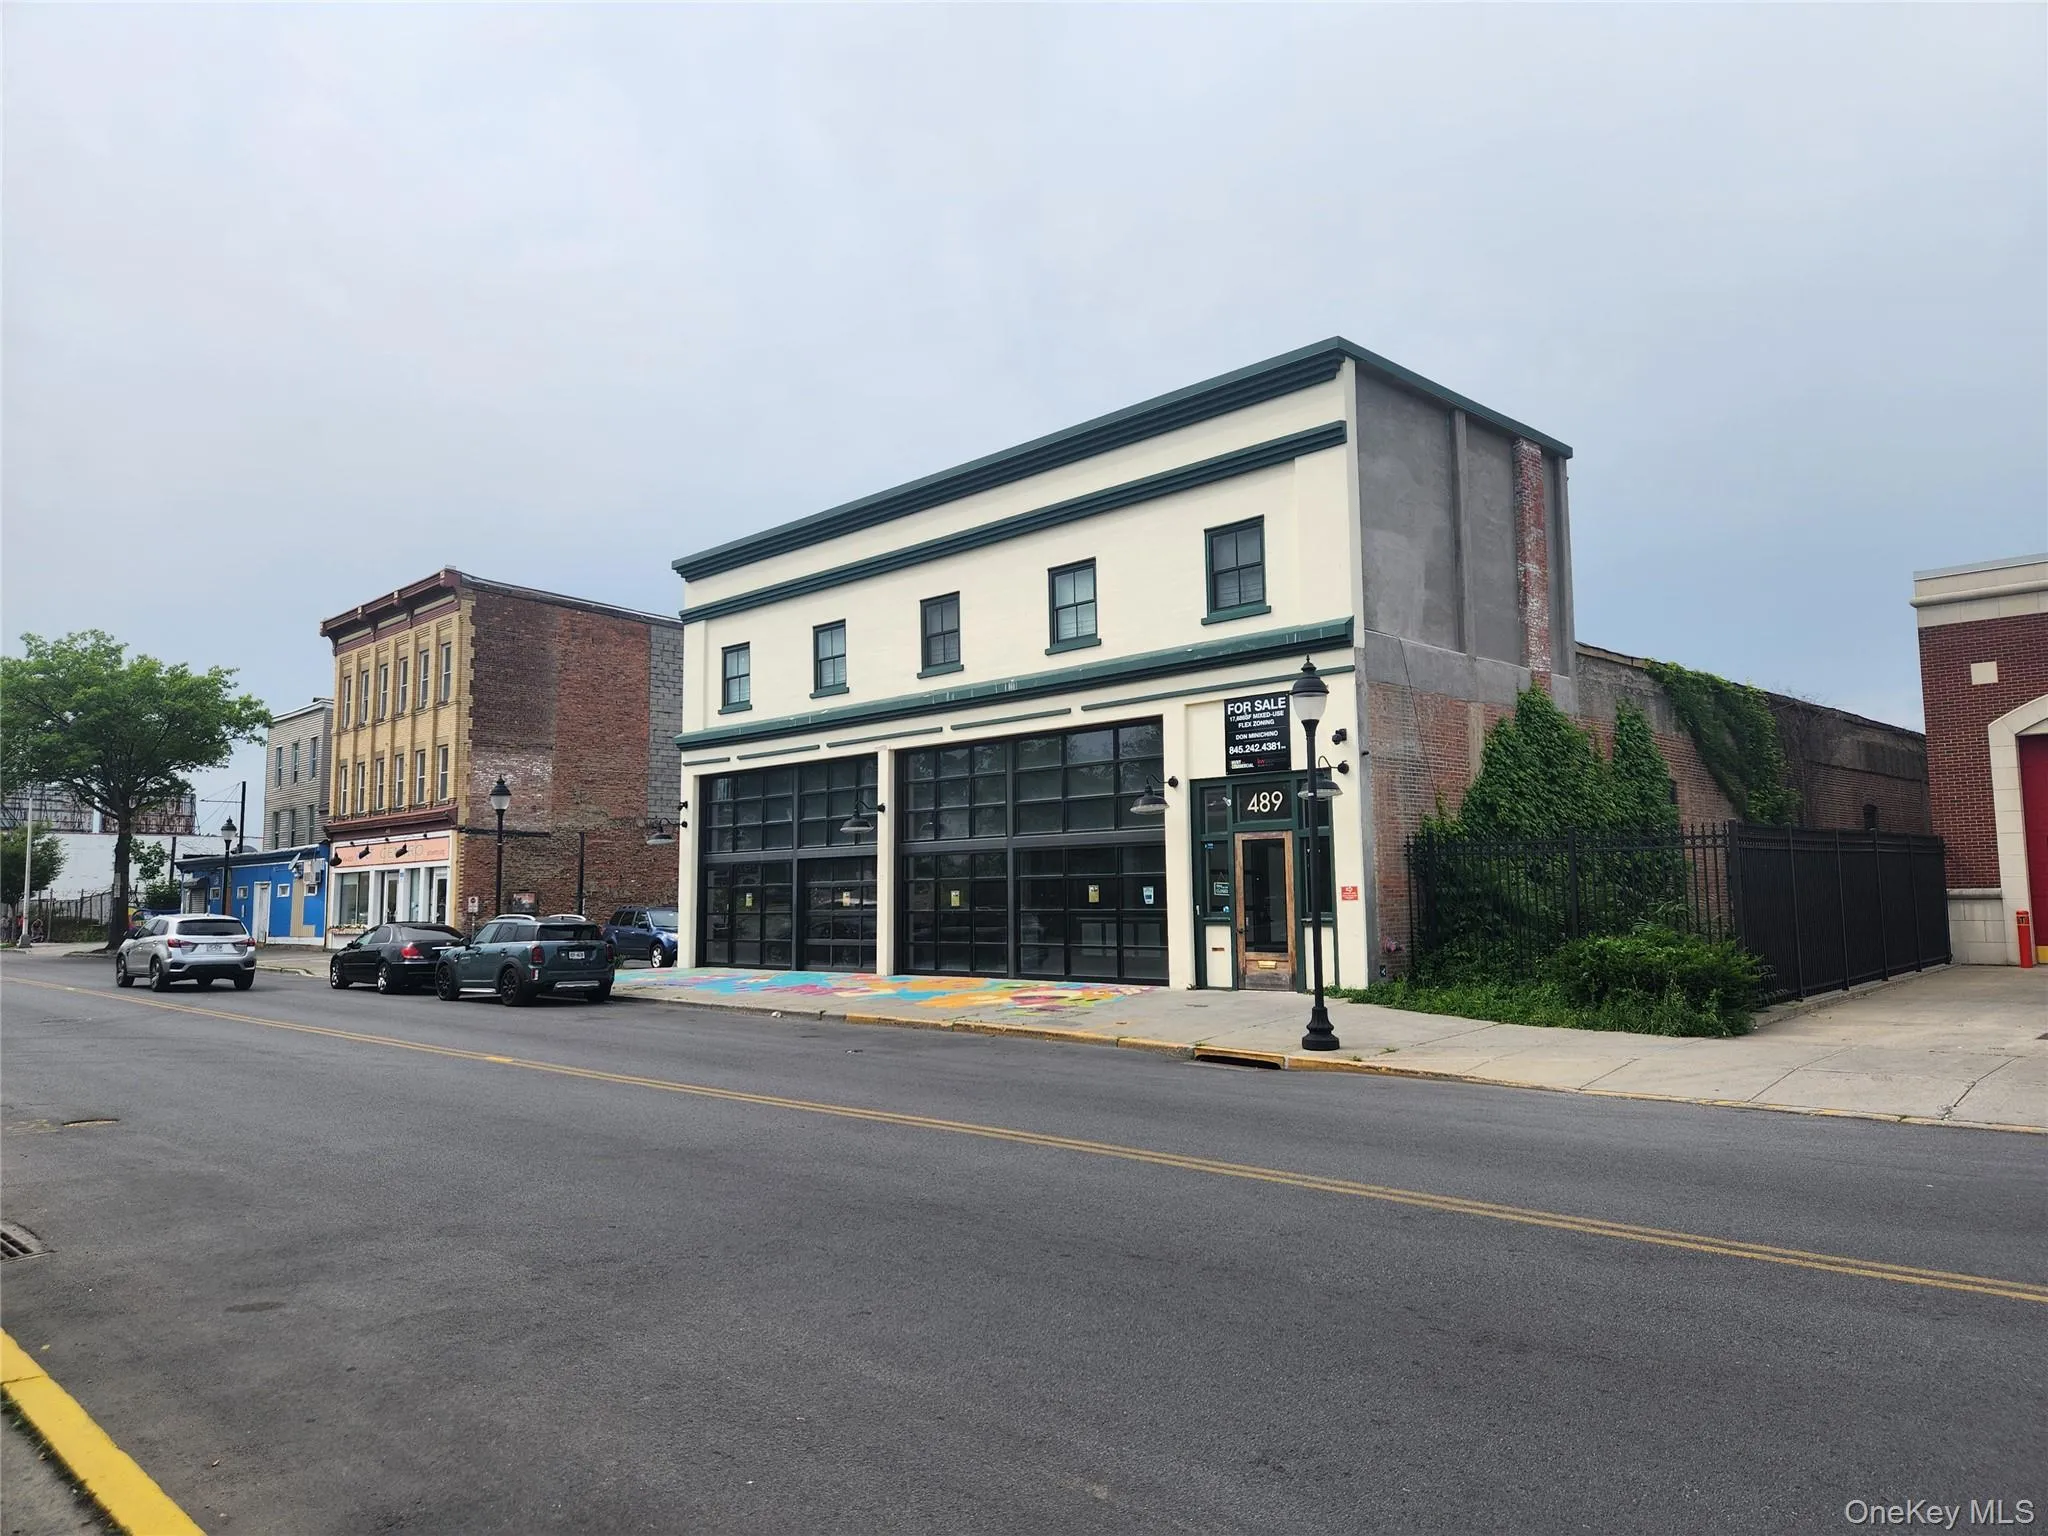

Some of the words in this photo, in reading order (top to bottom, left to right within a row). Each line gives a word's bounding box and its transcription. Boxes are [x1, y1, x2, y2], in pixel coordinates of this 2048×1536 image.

[1227, 702, 1251, 715] FOR
[1254, 697, 1286, 711] SALE
[1253, 710, 1284, 719] MIXED-USE
[1238, 721, 1252, 729] FLEX
[1253, 719, 1275, 727] ZONING
[1229, 742, 1280, 755] 845.242.4381
[1247, 791, 1283, 813] 489
